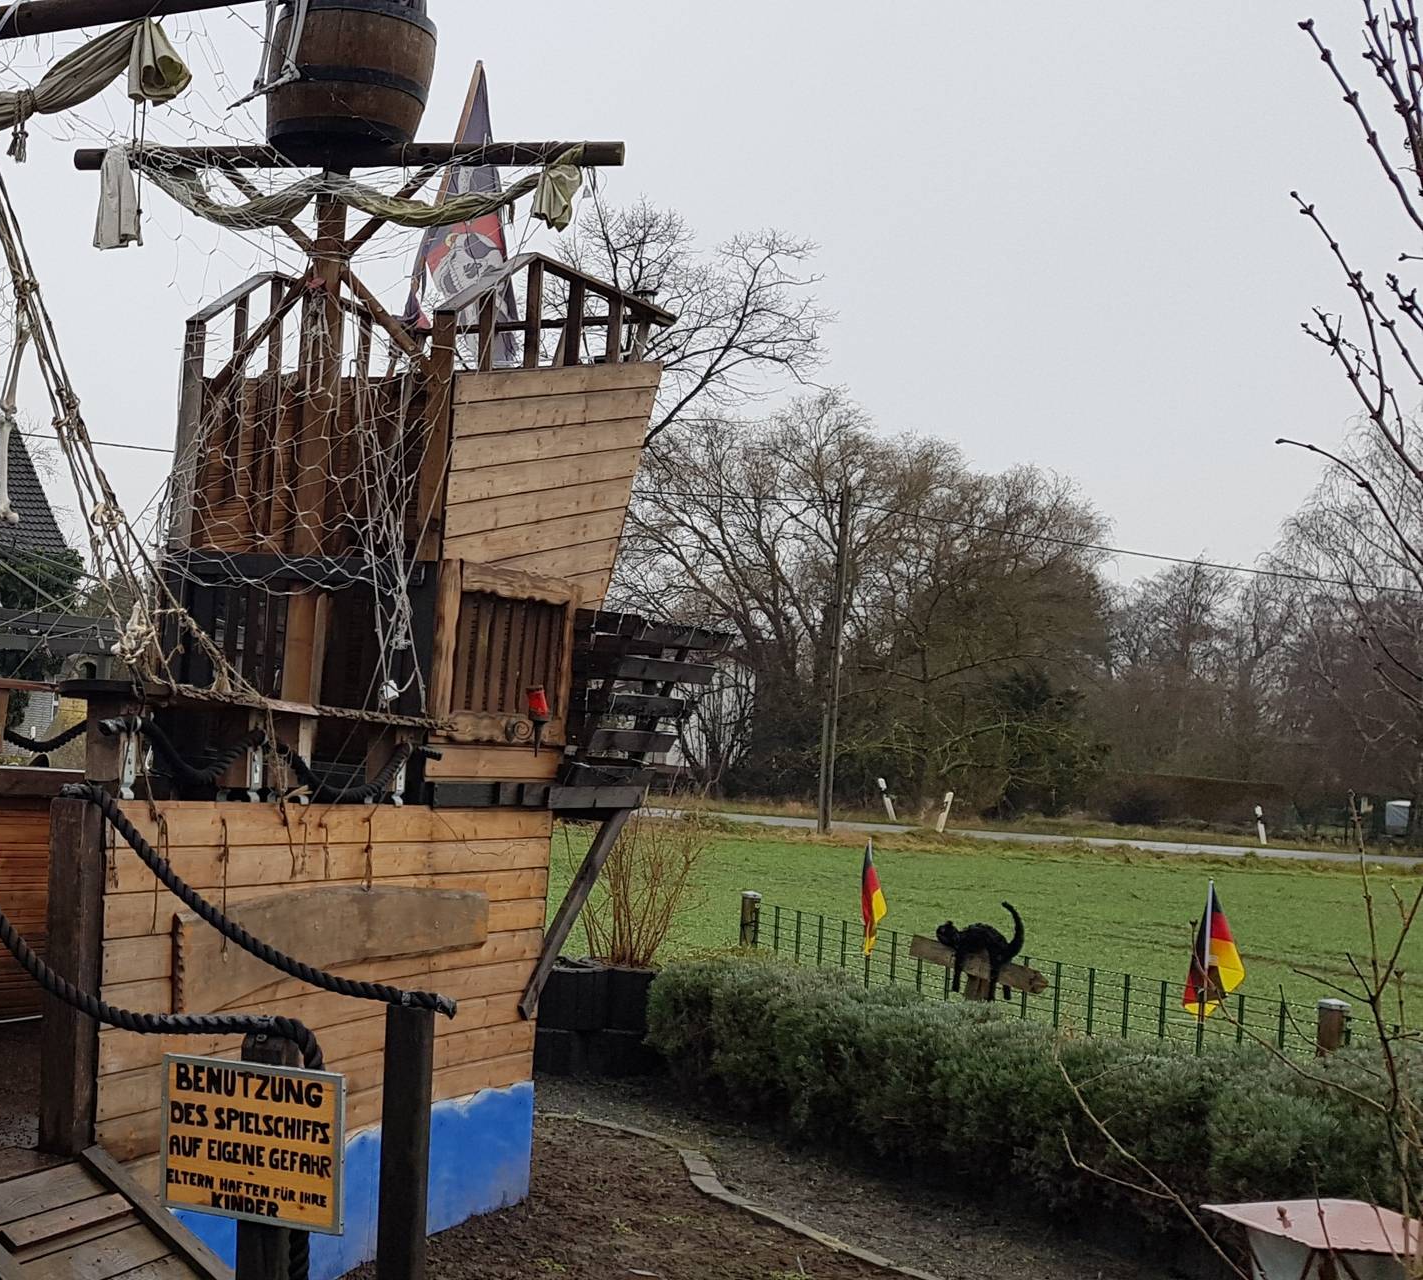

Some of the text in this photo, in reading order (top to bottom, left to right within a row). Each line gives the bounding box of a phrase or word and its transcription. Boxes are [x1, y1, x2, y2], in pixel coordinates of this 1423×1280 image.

[176, 1063, 323, 1108] BENUTZUNG
[170, 1100, 330, 1144] DES SPIELSCHIFFS
[169, 1134, 331, 1178] AUF EIGENE GEFAHR
[166, 1168, 327, 1208] ELTERN HAFTEN FÜR IHRE
[211, 1191, 279, 1217] KINDER
